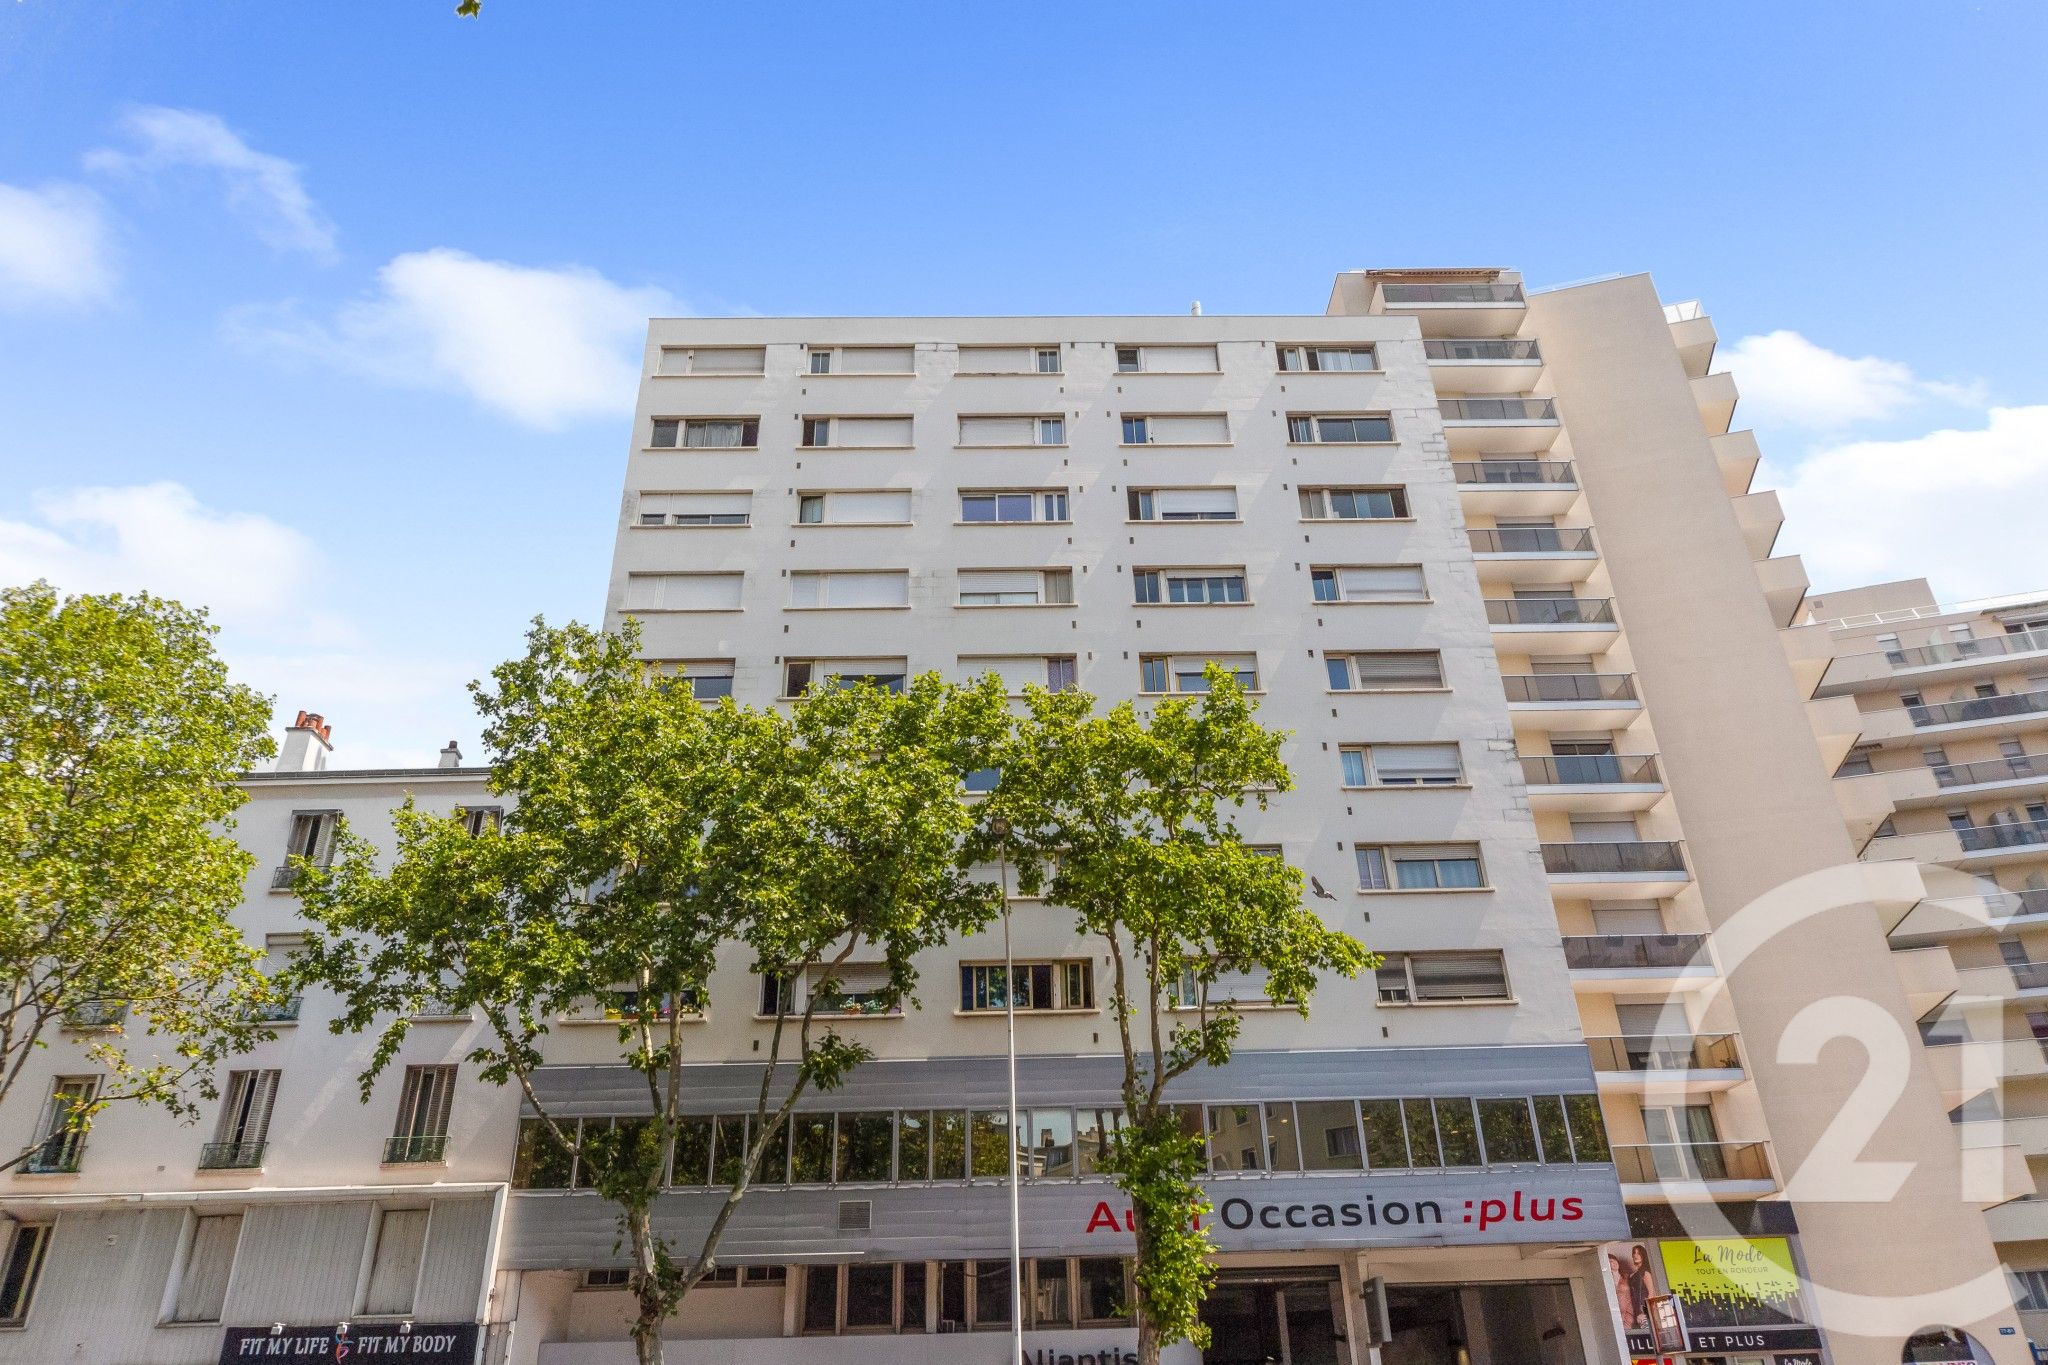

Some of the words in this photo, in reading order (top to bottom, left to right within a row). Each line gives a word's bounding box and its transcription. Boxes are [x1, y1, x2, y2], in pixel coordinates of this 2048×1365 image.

[1086, 1200, 1200, 1233] Ai
[1220, 1195, 1442, 1230] Occasion
[1463, 1191, 1584, 1231] :plus
[1693, 1245, 1712, 1264] La
[1717, 1244, 1764, 1266] Mode
[1730, 1266, 1769, 1274] RONDEUR
[239, 1338, 265, 1355] FIT
[265, 1337, 293, 1355] MY
[294, 1337, 330, 1354] LIFE
[357, 1336, 384, 1354] FIT
[385, 1336, 412, 1353] MY
[413, 1335, 457, 1353] BODY
[1629, 1338, 1654, 1350] ILL
[1698, 1336, 1716, 1348] ET
[1725, 1335, 1765, 1347] PLUS
